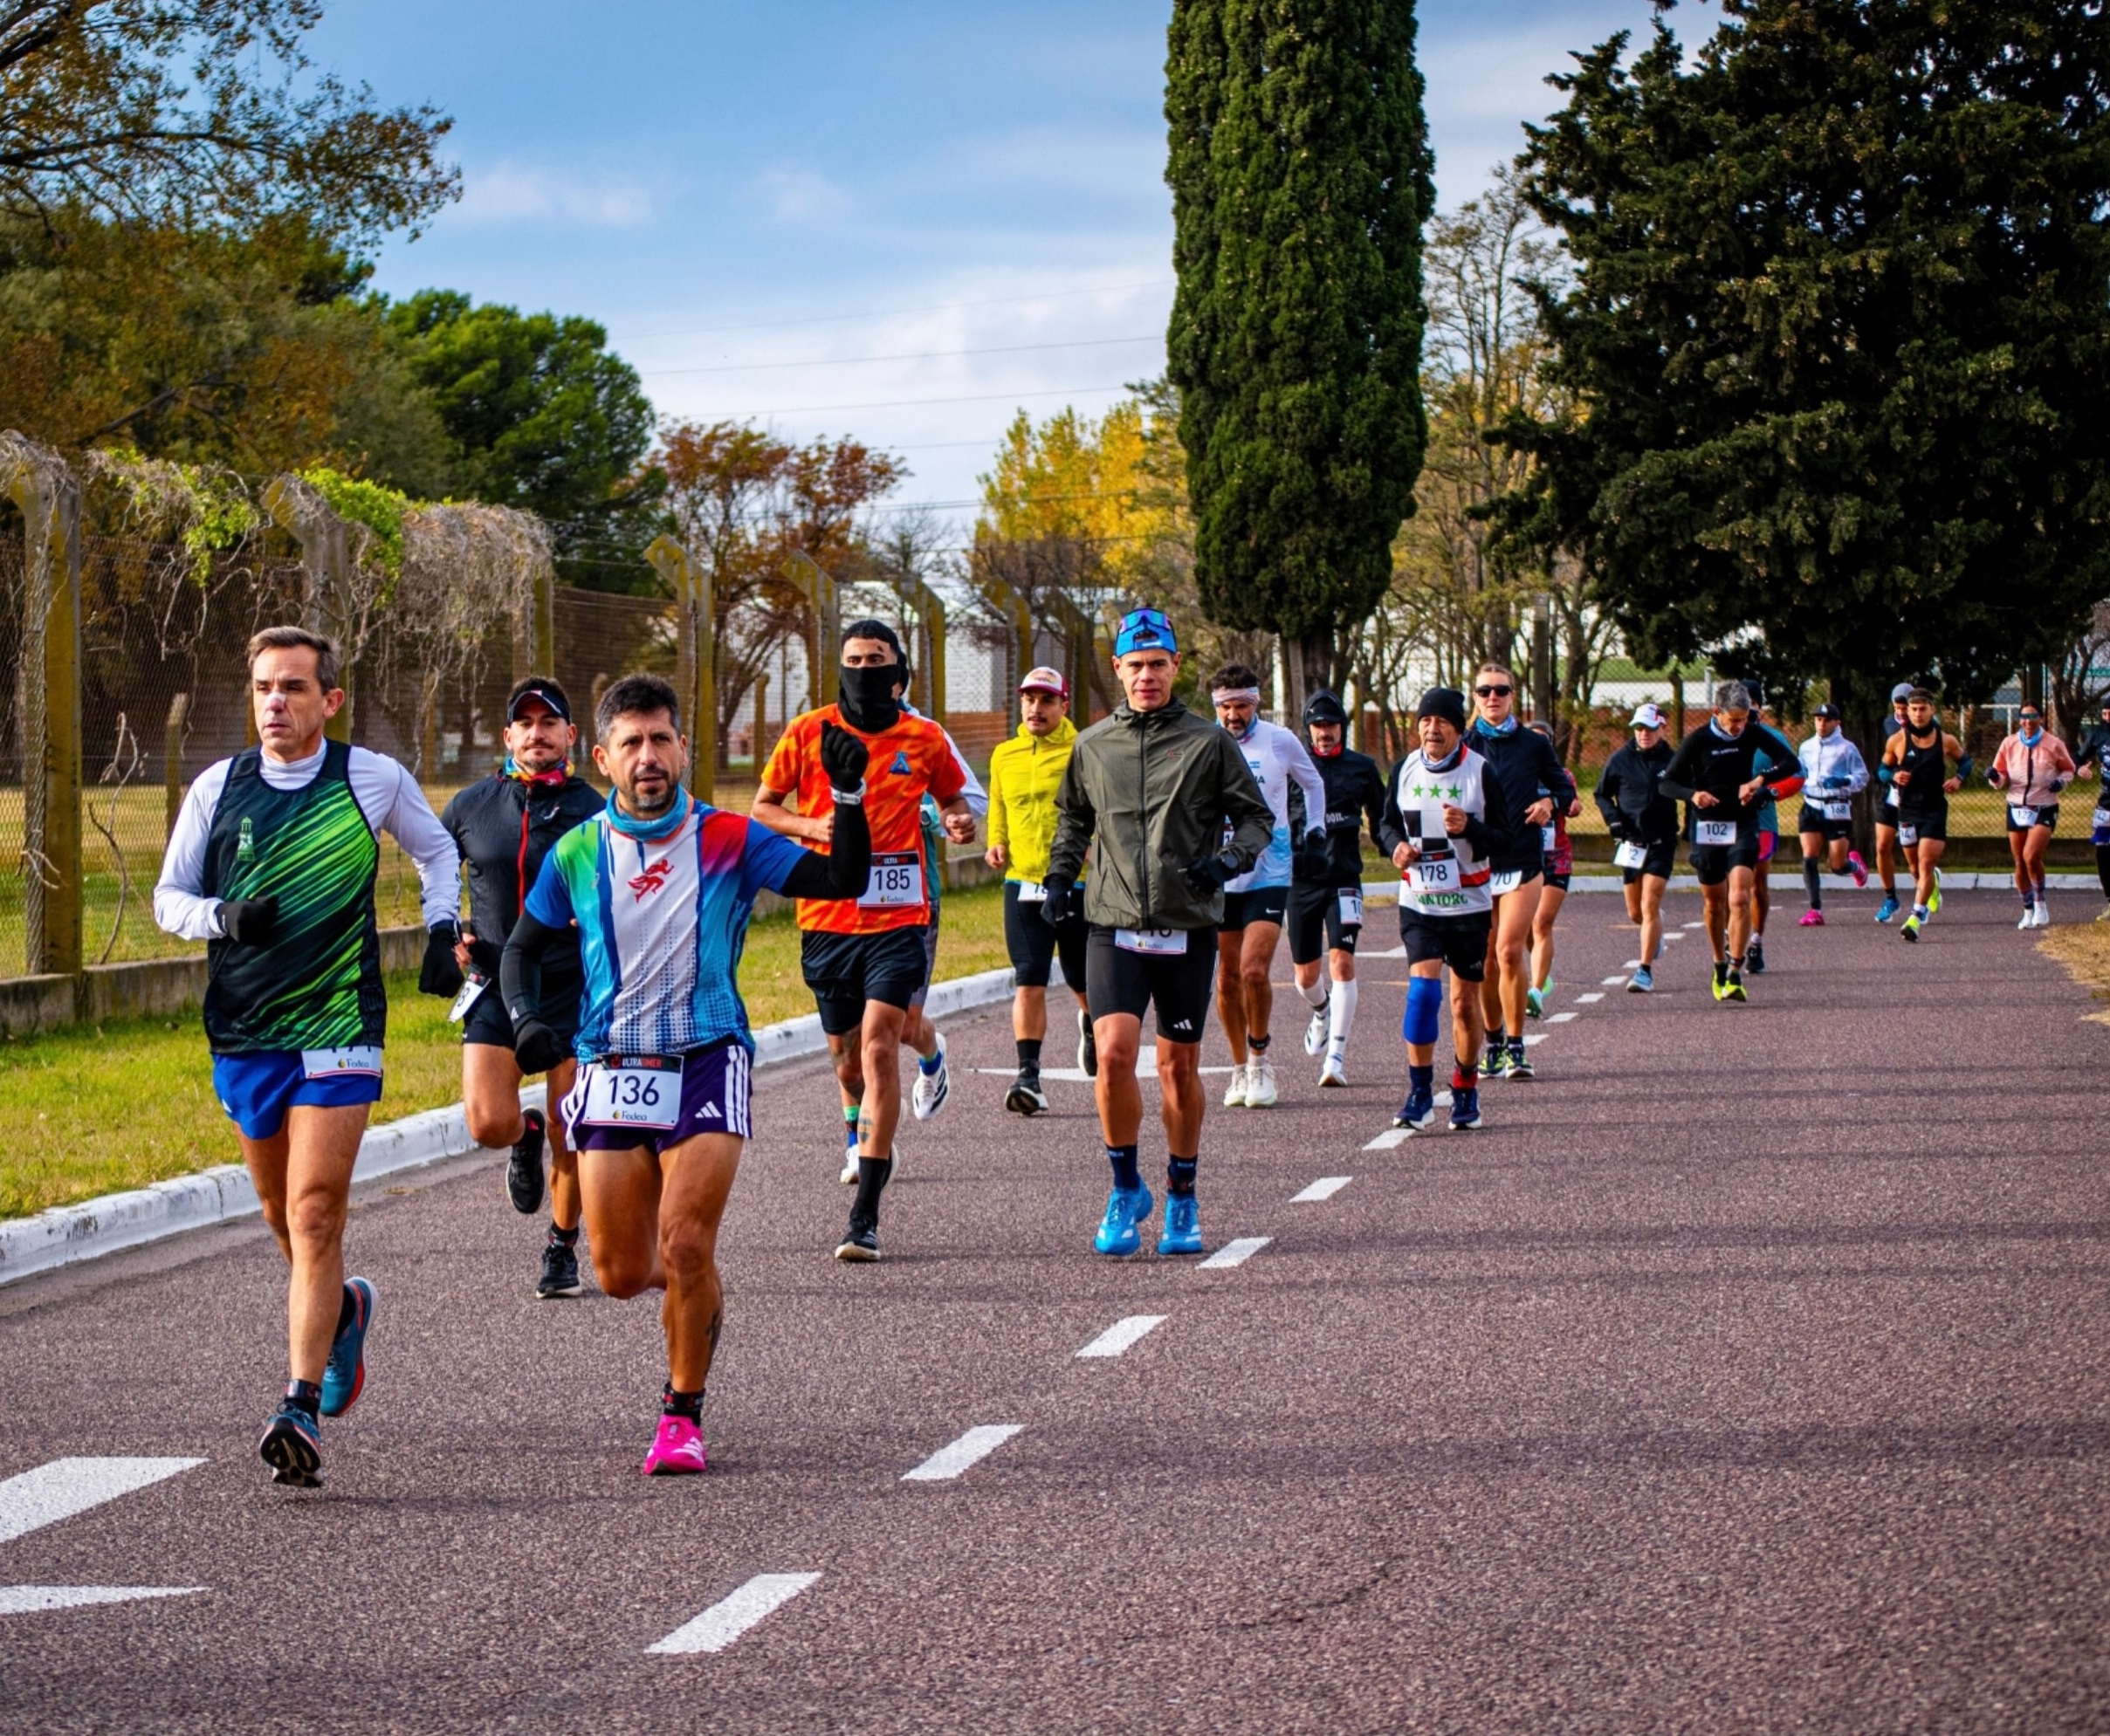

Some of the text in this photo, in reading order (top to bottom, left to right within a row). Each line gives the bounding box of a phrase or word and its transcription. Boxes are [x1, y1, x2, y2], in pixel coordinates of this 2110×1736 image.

[1705, 823, 1728, 835] 102
[874, 868, 911, 891] 185
[1417, 864, 1448, 882] 178
[608, 1074, 660, 1106] 136
[621, 1110, 648, 1122] Fedea
